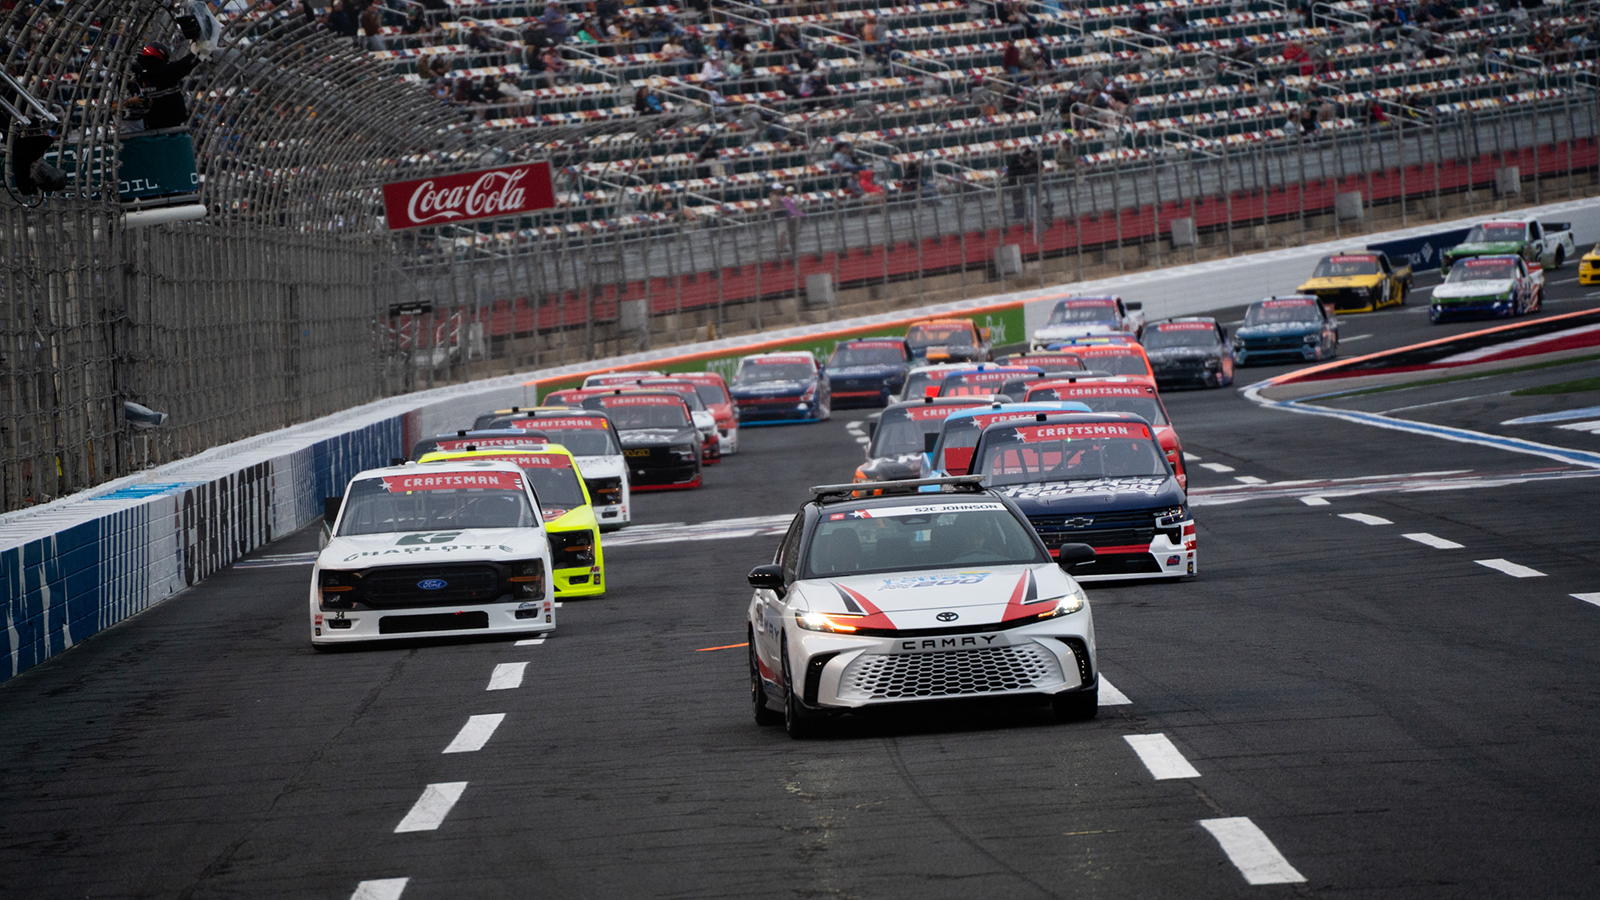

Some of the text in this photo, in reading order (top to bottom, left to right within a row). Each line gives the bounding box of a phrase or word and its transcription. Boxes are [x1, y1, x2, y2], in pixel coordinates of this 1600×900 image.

[407, 167, 530, 223] Coca-Cola
[1069, 388, 1139, 396] CRAFTSMAN
[612, 397, 668, 405] CRAFTSMAN
[525, 419, 592, 428] CRAFTSMAN
[1037, 426, 1128, 437] CRAFTSMAN
[404, 476, 499, 487] CRAFTSMAN
[940, 504, 998, 512] JOHNSON
[183, 460, 271, 587] CHARLOTTE
[422, 580, 442, 589] Ford
[335, 611, 345, 620] 34
[902, 634, 998, 651] CAMRY
